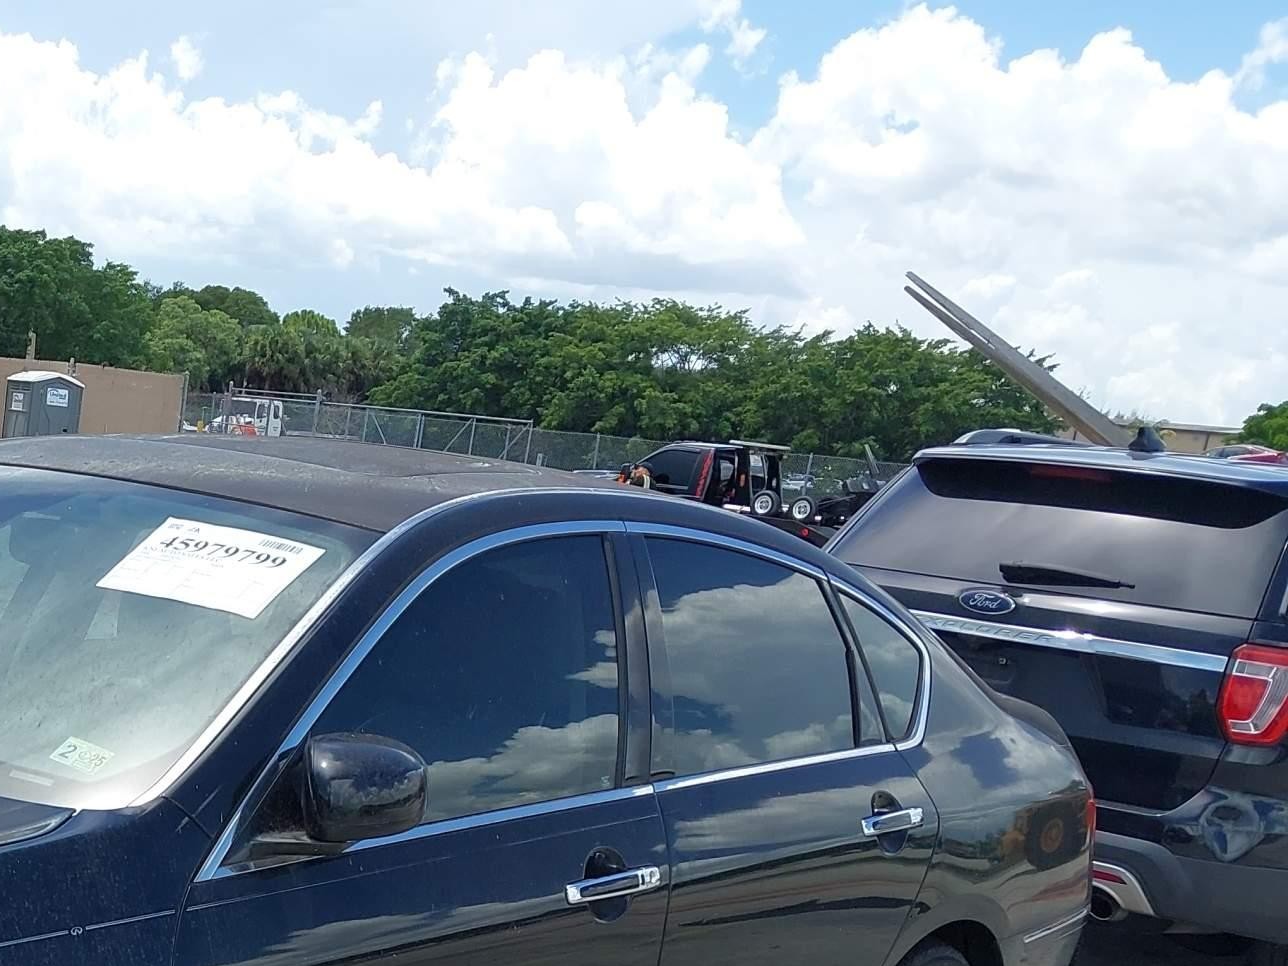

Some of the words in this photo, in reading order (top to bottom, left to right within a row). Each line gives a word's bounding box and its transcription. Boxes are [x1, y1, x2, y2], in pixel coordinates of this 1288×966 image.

[159, 535, 287, 568] 45979799
[969, 592, 1002, 609] Ford
[57, 744, 77, 759] 2
